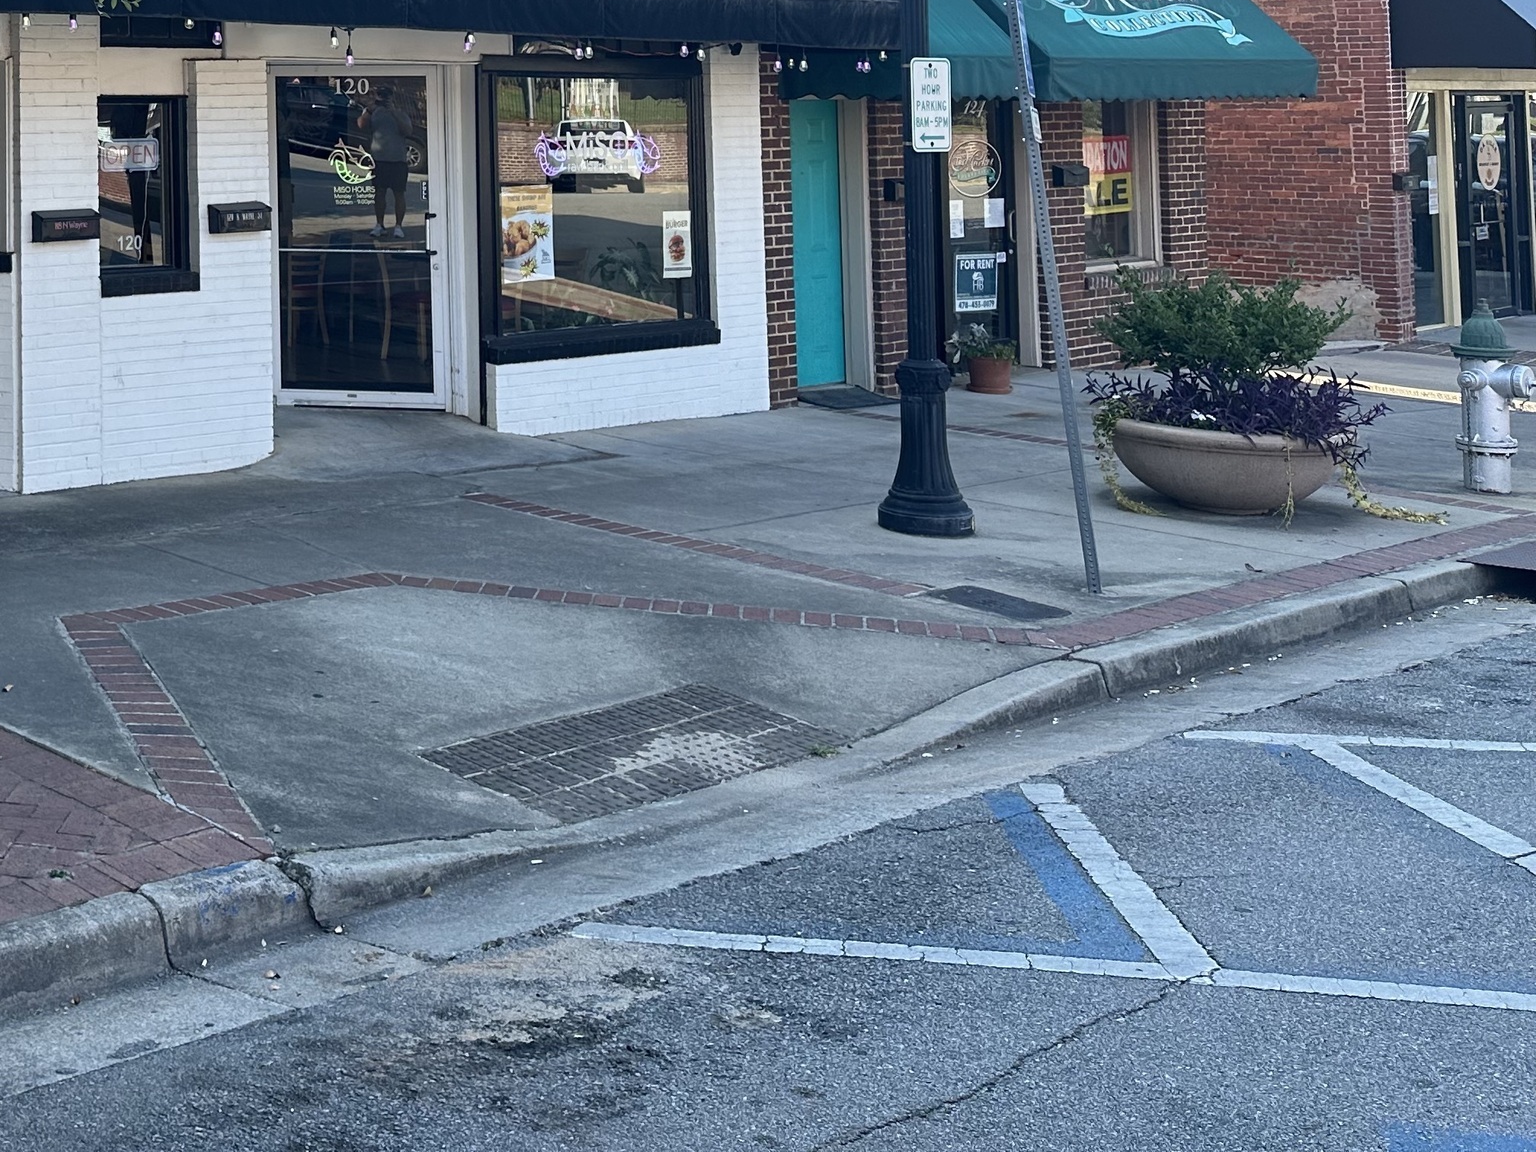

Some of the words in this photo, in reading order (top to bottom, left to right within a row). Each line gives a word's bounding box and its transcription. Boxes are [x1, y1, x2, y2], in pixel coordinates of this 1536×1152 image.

[1089, 9, 1213, 34] COLLECTIVE
[924, 68, 938, 79] TWO
[334, 78, 370, 95] 120
[921, 84, 941, 95] HOUR
[916, 100, 947, 111] PARKING
[964, 100, 987, 118] 124
[106, 144, 156, 164] OPEN
[352, 186, 376, 194] HOURS
[69, 220, 89, 230] Wayne
[117, 235, 143, 252] 120
[960, 259, 975, 270] FOR
[977, 259, 995, 270] RENT
